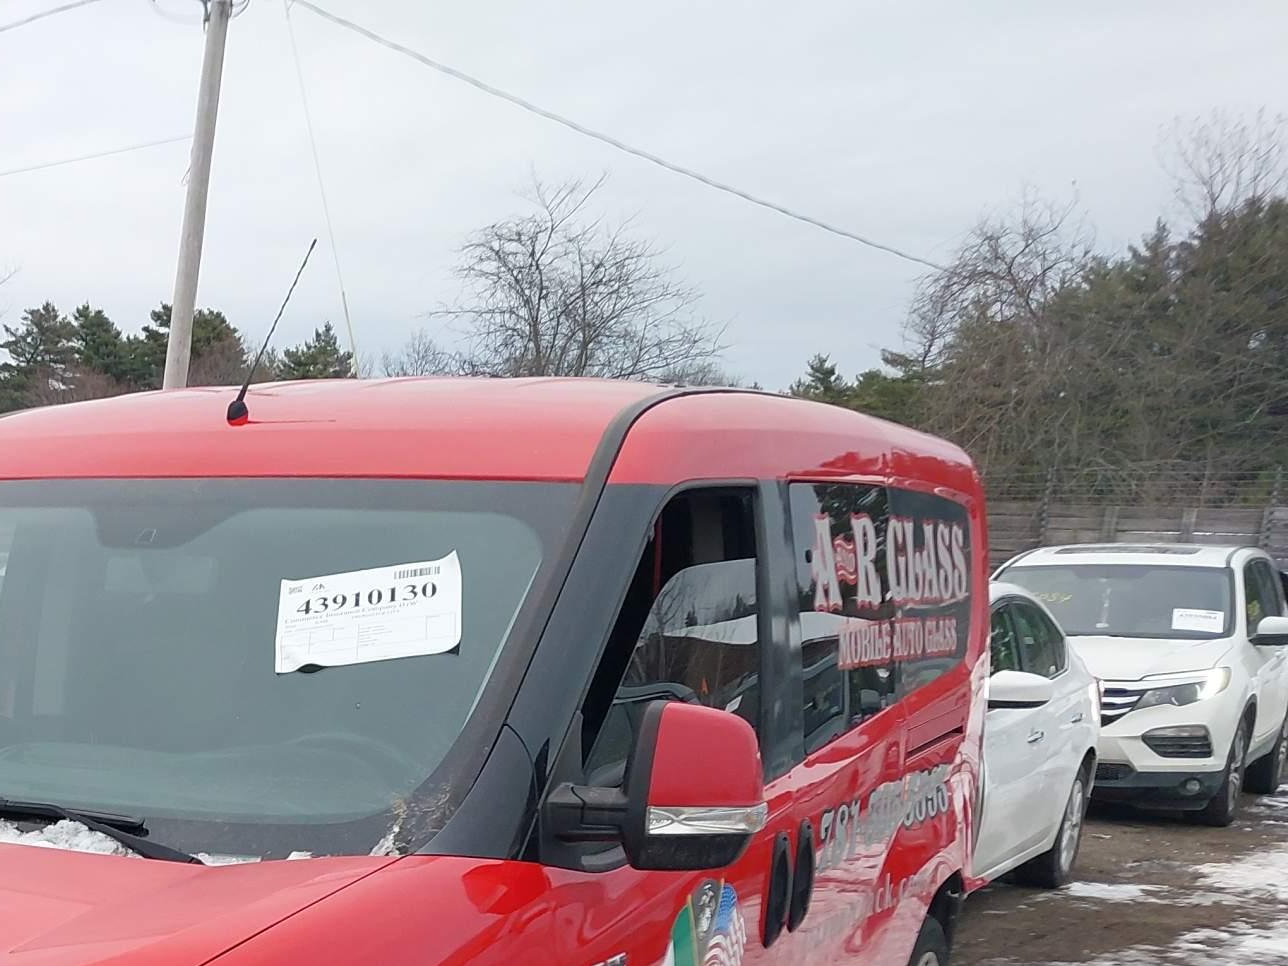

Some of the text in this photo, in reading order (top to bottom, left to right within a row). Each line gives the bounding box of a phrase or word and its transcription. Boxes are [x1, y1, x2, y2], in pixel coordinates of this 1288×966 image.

[812, 513, 843, 611] A
[850, 513, 882, 609] R
[886, 516, 968, 603] GLASS
[296, 581, 438, 615] 43910130
[838, 617, 958, 669] MOBILE AUTO GLASS
